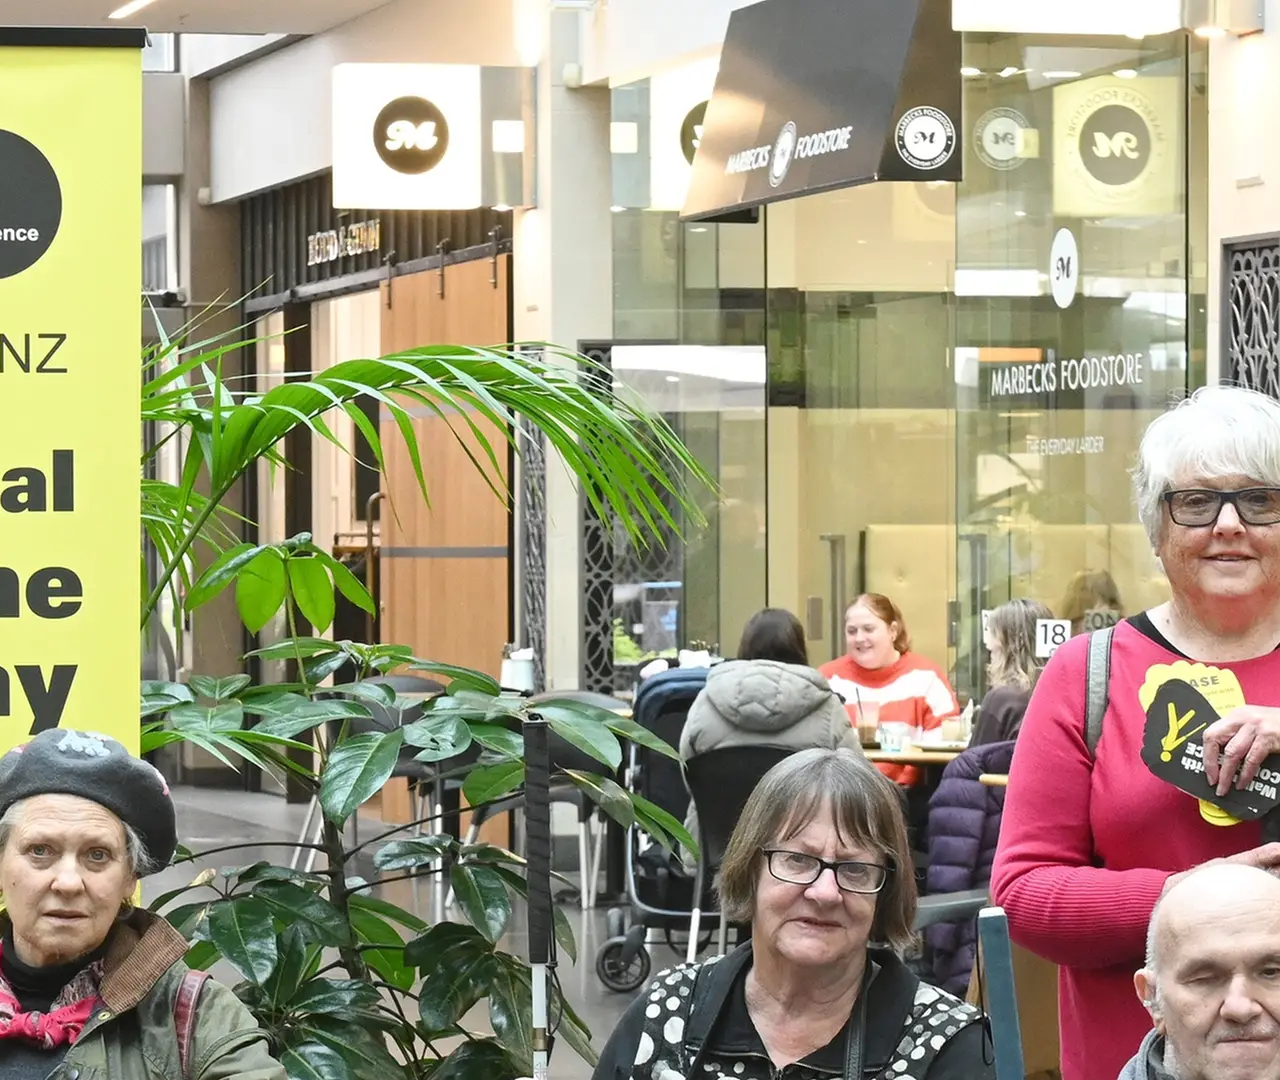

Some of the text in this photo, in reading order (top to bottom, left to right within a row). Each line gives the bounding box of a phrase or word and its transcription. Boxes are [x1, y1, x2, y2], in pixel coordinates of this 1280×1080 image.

[794, 125, 854, 159] FOODSTORE
[991, 353, 1144, 397] MARBECKS FOODSTORE
[1040, 623, 1067, 645] 18
